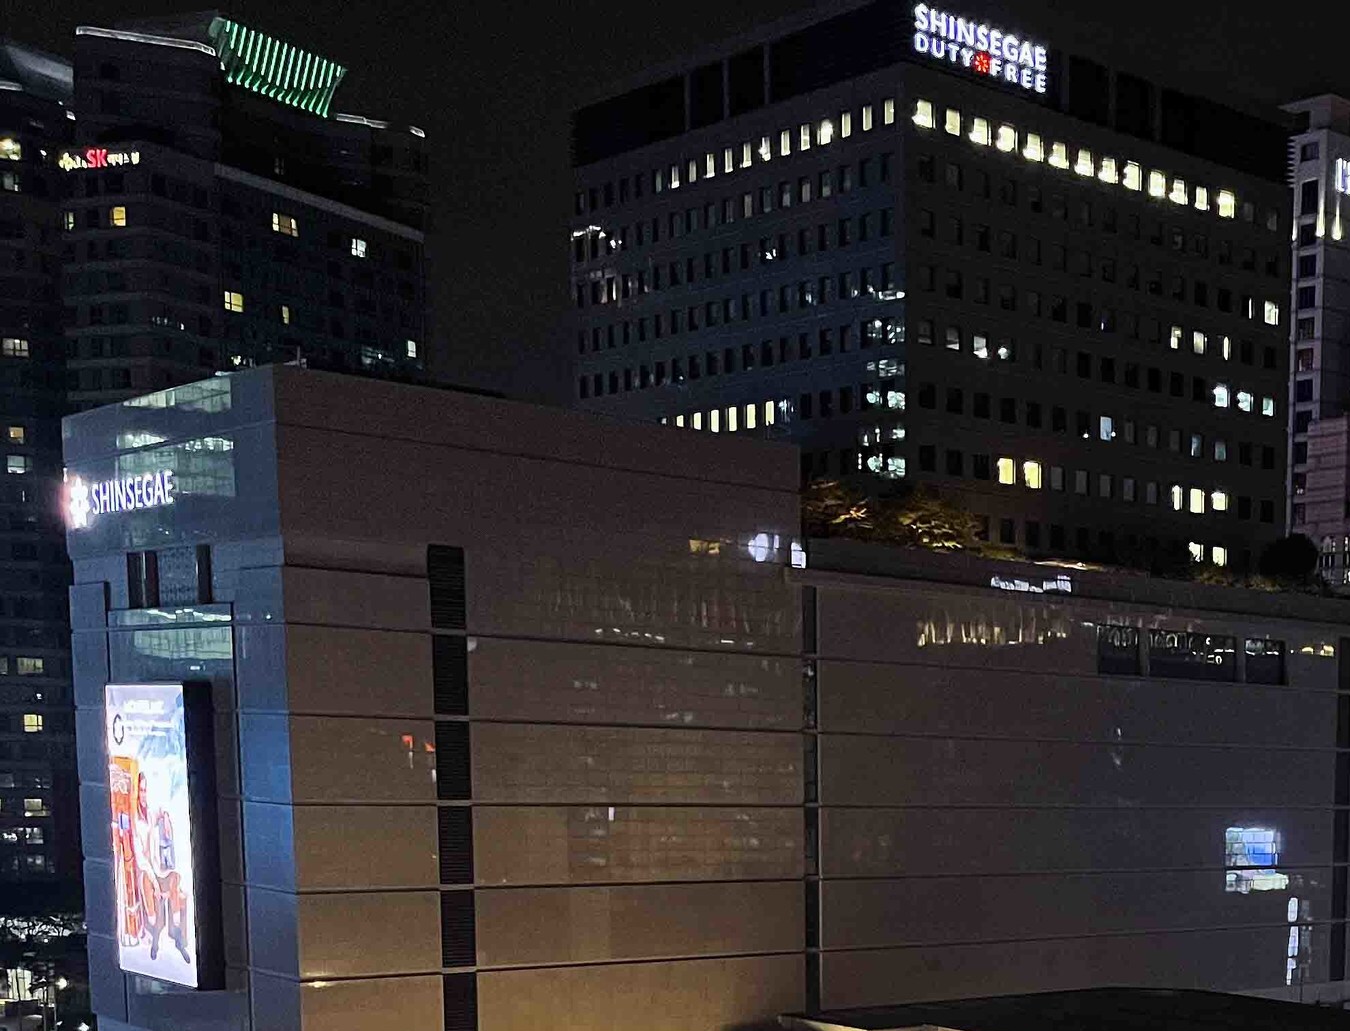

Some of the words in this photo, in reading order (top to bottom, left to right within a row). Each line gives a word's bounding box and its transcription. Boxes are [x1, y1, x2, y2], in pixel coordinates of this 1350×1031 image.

[914, 3, 1047, 72] SHINSEGAE
[914, 32, 974, 67] DUTY
[990, 58, 1047, 93] FREE
[86, 148, 108, 168] SK
[91, 469, 175, 514] SHINSEGAE
